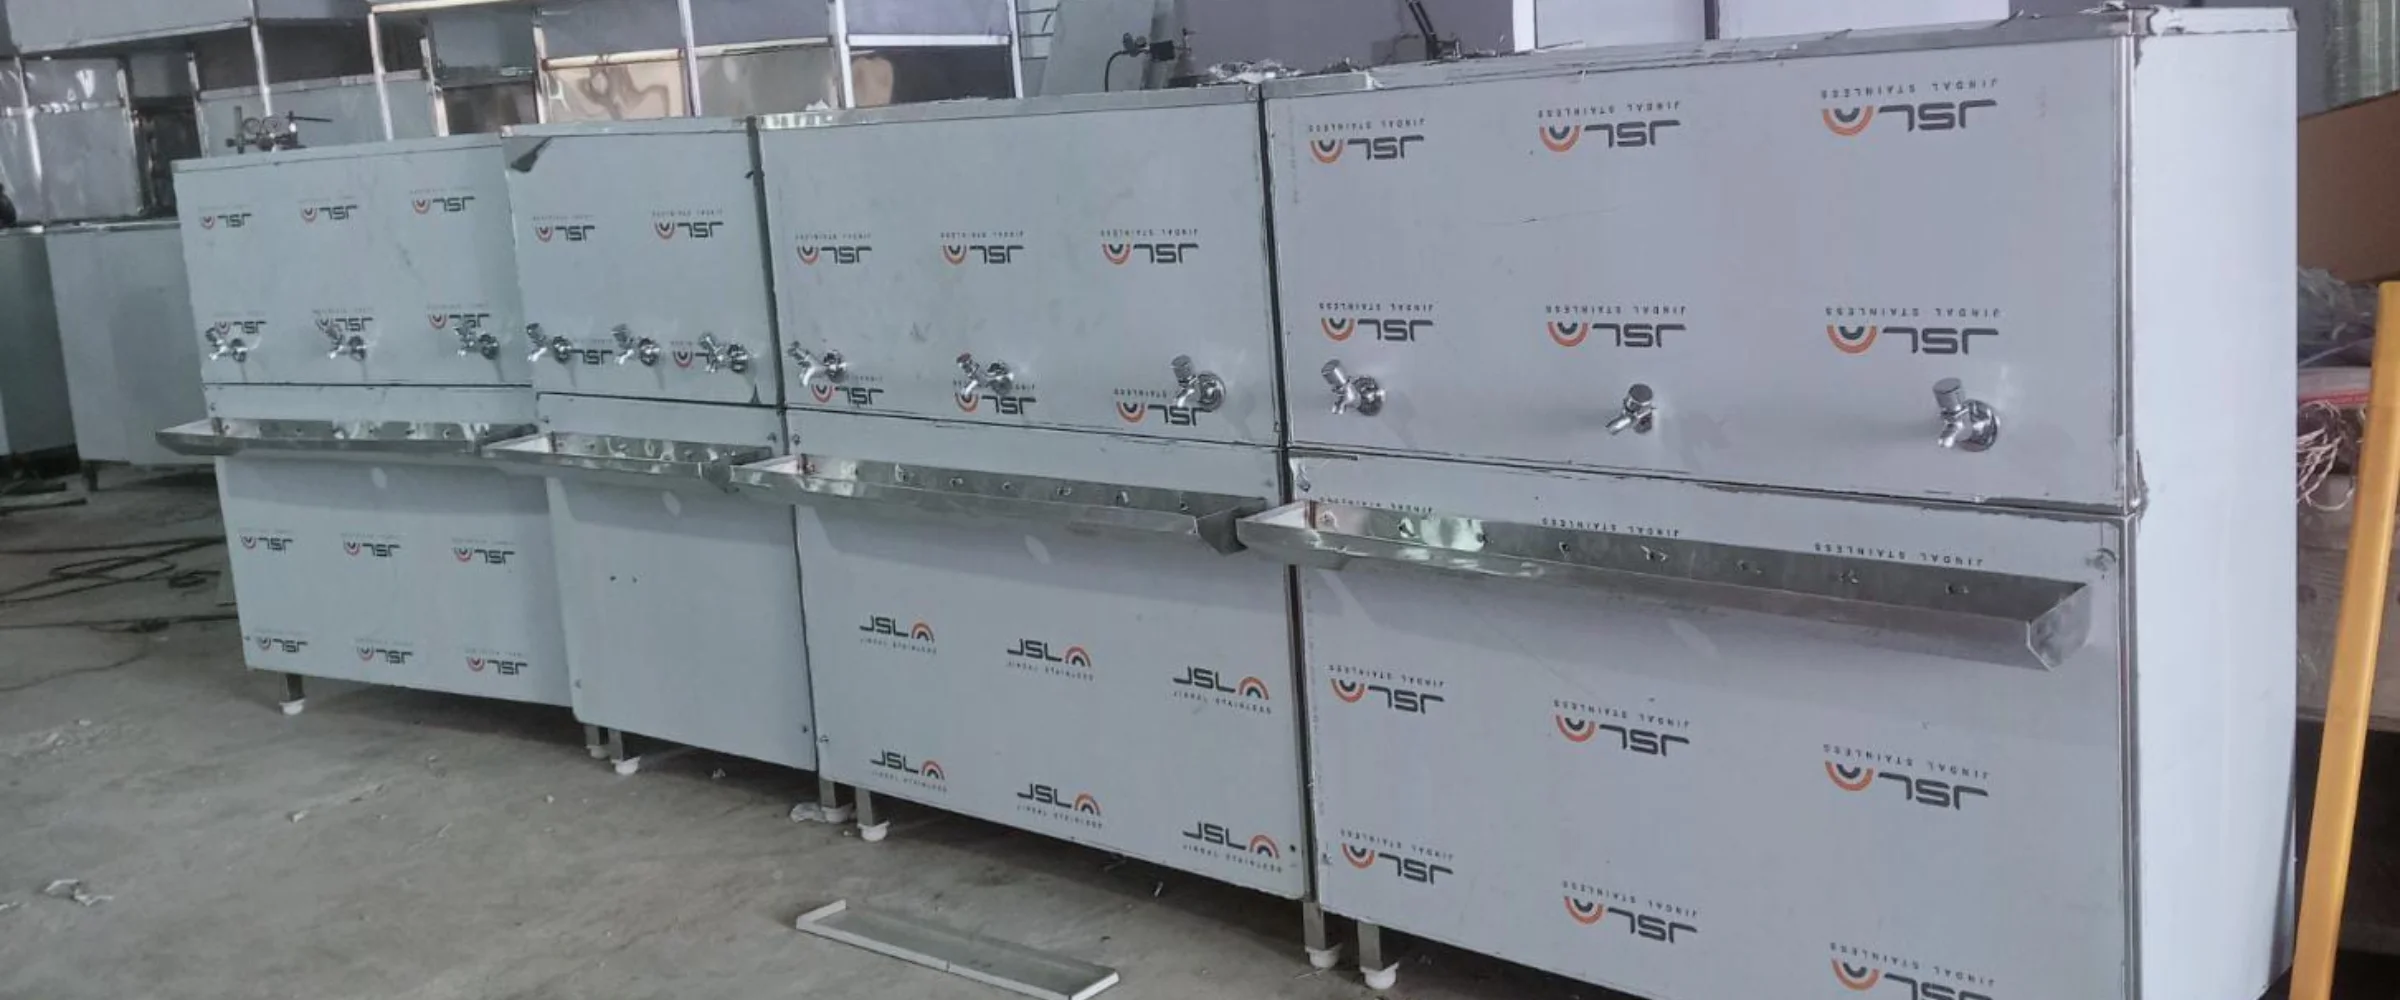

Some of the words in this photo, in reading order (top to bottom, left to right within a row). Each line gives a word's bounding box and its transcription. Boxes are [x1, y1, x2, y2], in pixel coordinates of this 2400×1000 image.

[1821, 83, 1916, 100] STAINLESS
[1932, 77, 1998, 91] JINDAL
[1878, 99, 1998, 132] JSL
[1584, 119, 1681, 148] JSL
[1347, 134, 1424, 161] JSL
[677, 221, 724, 238] JSL
[820, 246, 872, 264] JSL
[969, 245, 1025, 264] JSL
[1133, 243, 1199, 264] JSL
[1825, 307, 1919, 317] STAINLESS
[1935, 308, 2000, 318] JINDAL
[1357, 318, 1433, 342] JSL
[1592, 323, 1686, 348] JSL
[1882, 326, 1999, 355] JSL
[834, 386, 884, 405] JSL
[981, 395, 1036, 415] JSL
[1147, 404, 1213, 426] JSL
[1920, 552, 1983, 566] JINDAL
[859, 615, 909, 638] JSL
[1007, 638, 1062, 663] JSL
[1172, 665, 1236, 693] JSL
[1368, 684, 1444, 714] JSL
[1599, 724, 1690, 757] JSL
[870, 749, 919, 773] JSL
[1824, 744, 1913, 767] STAINLESS
[1928, 761, 1989, 780] JINDAL
[1017, 783, 1072, 809] JSL
[1878, 772, 1989, 810] JSL
[1182, 821, 1246, 851] JSL
[1378, 852, 1453, 885] JSL
[1607, 906, 1697, 943] JSL
[1934, 966, 1995, 987] JINDAL
